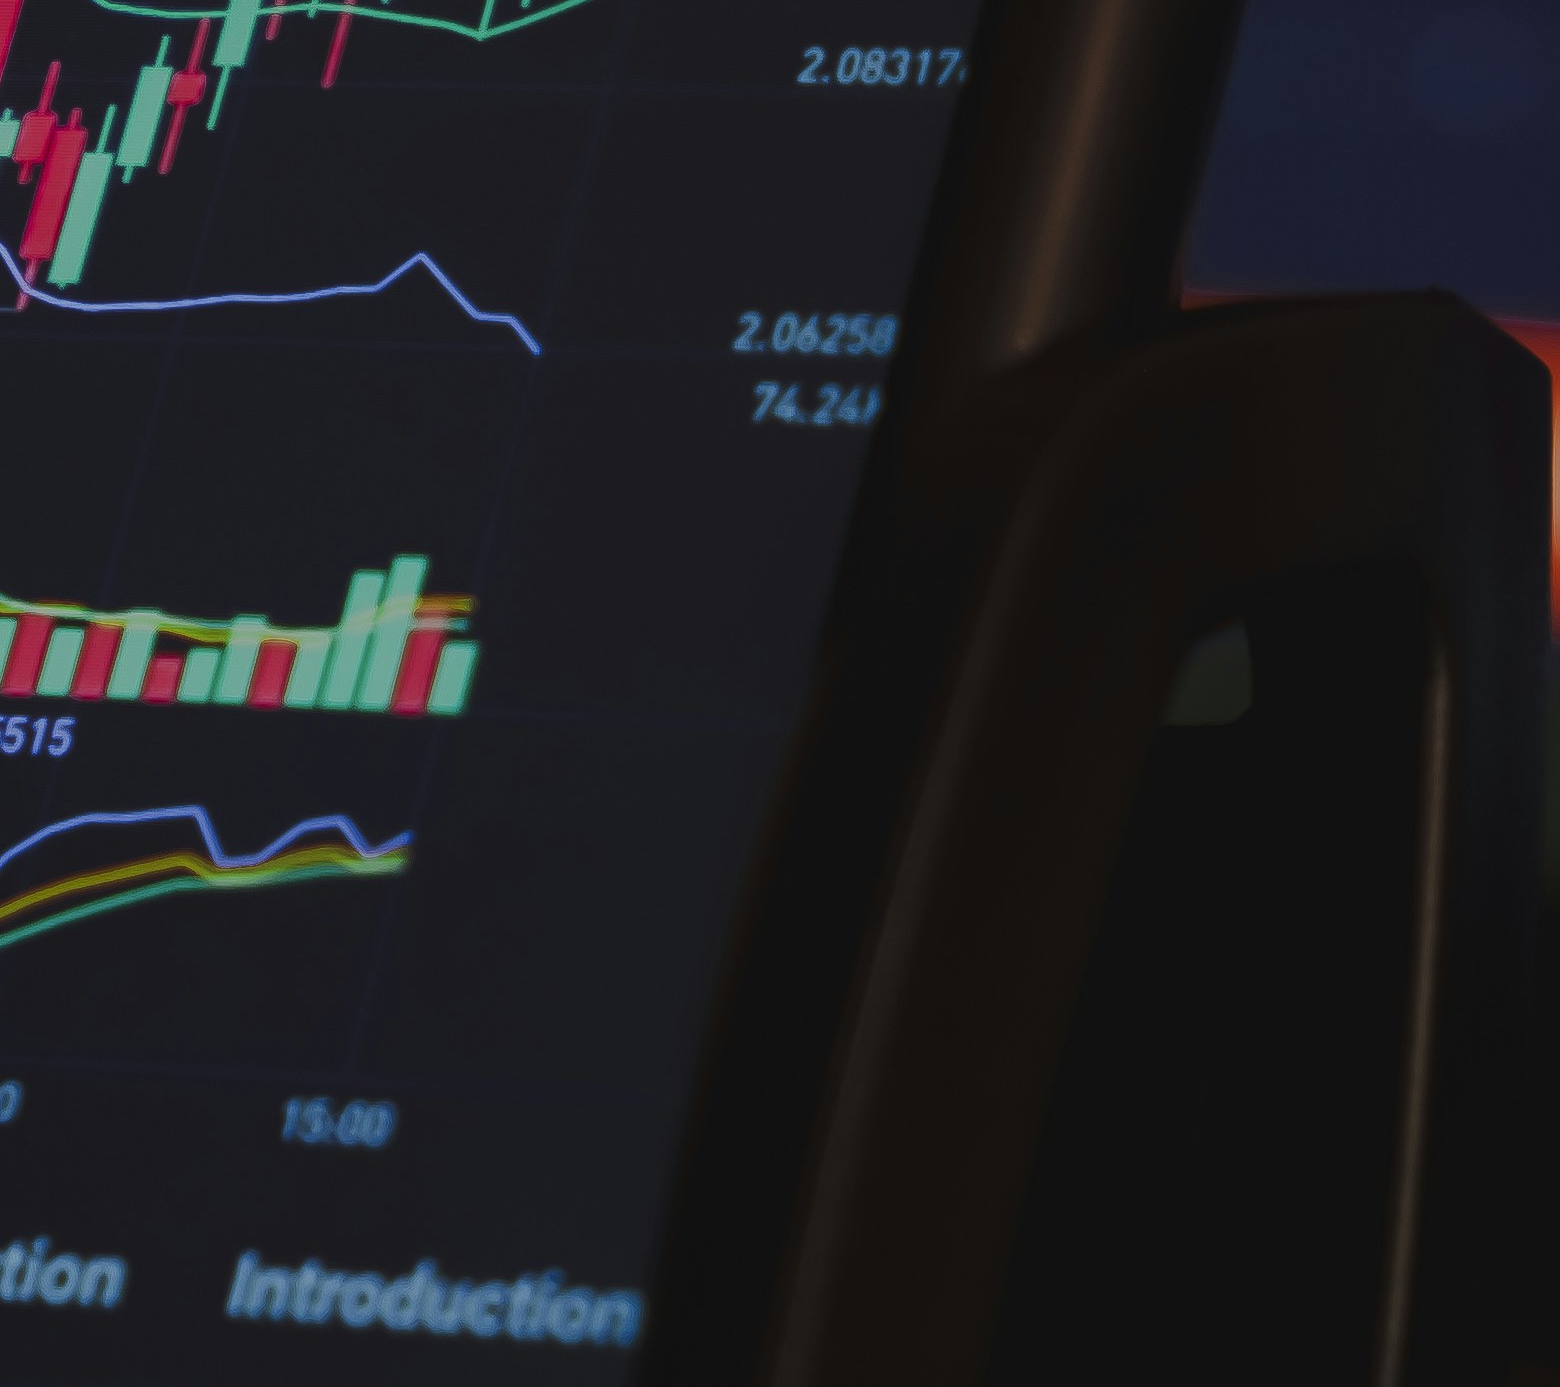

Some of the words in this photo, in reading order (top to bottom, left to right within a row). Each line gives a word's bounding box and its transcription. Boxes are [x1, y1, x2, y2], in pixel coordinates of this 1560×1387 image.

[795, 44, 966, 87] 2.08317
[281, 1096, 396, 1149] 15:00
[225, 1250, 643, 1346] Introduction
